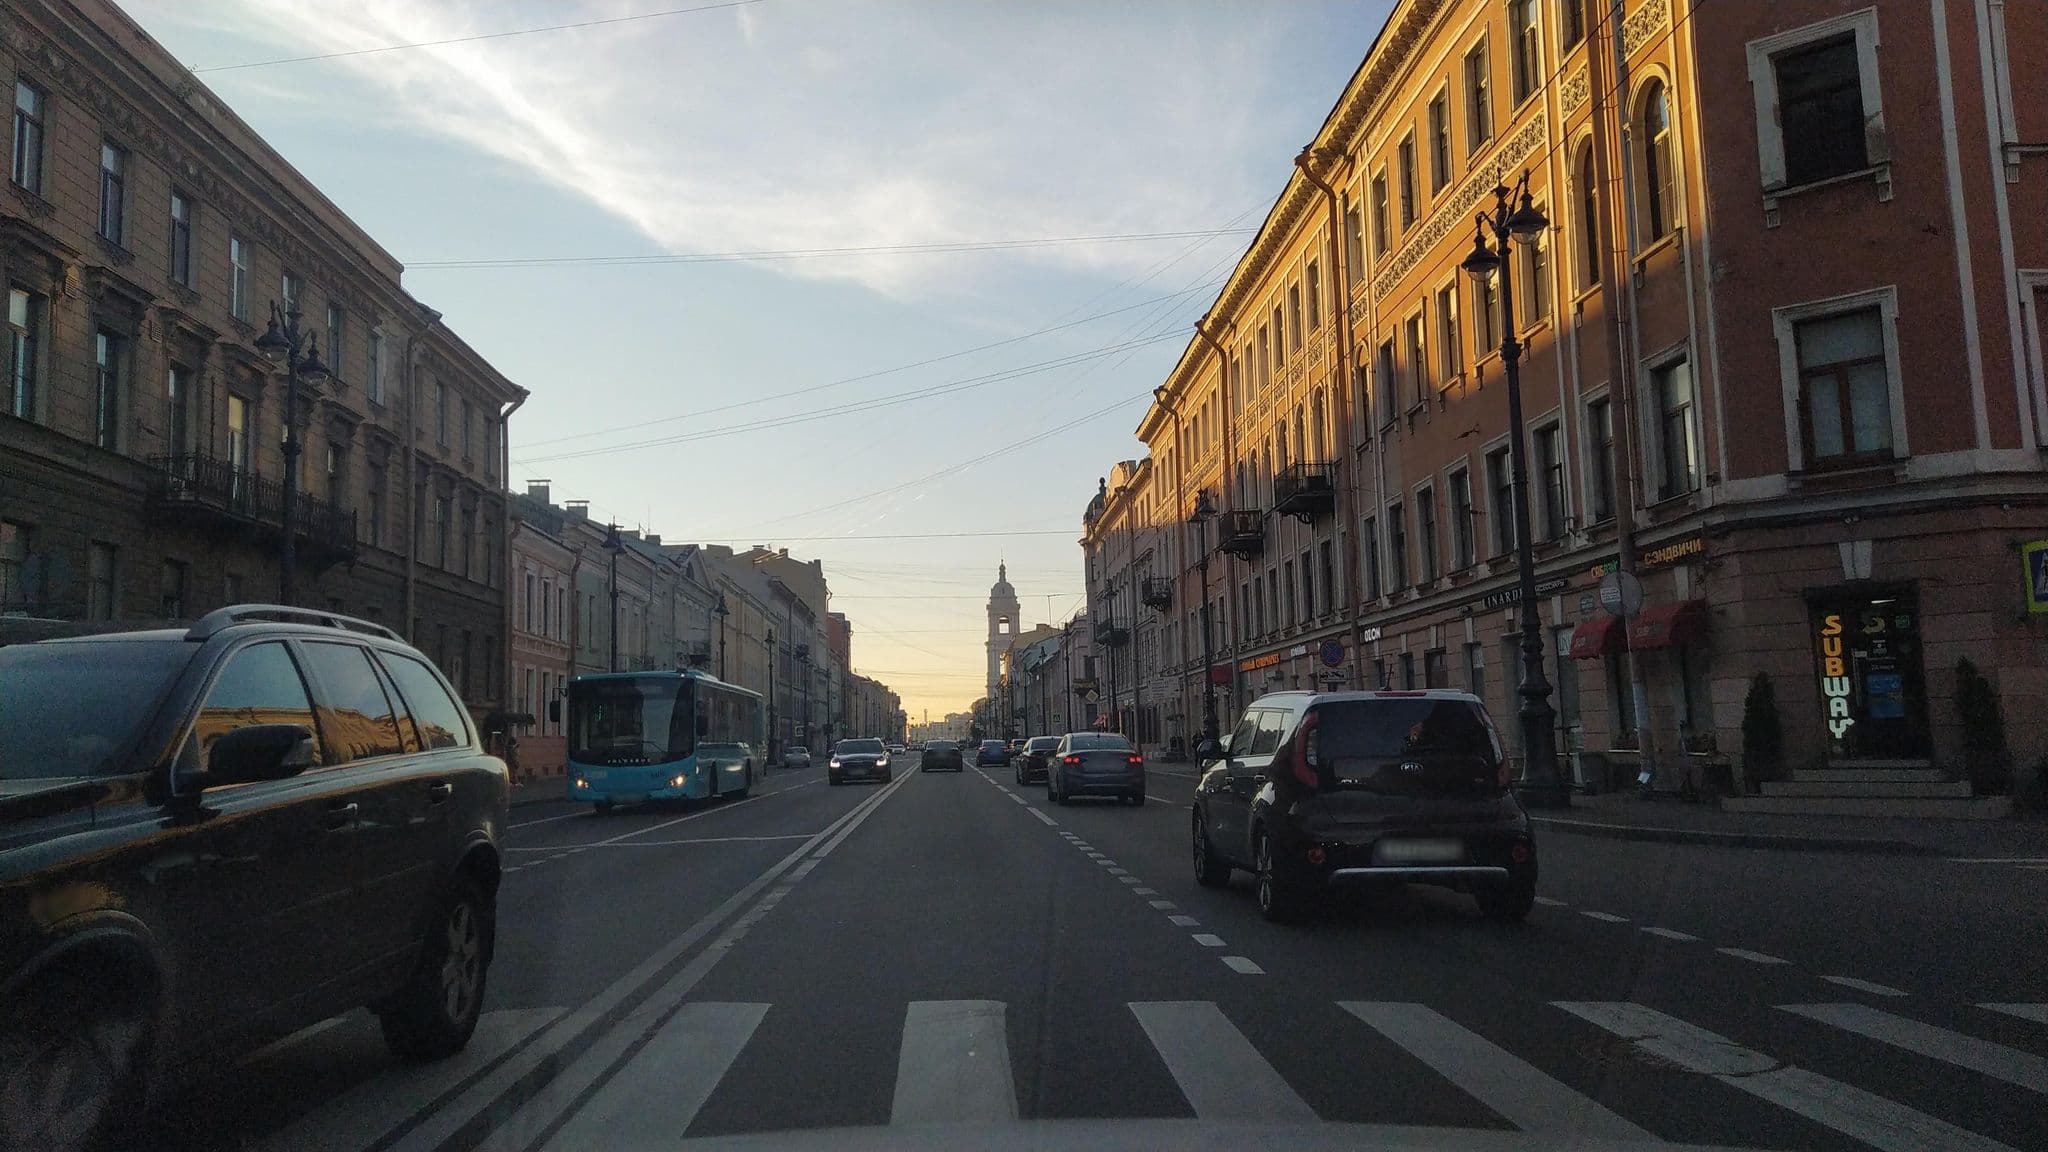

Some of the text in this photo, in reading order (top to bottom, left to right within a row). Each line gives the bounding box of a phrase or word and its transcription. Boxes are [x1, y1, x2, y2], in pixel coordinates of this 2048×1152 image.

[1644, 538, 1703, 566] СЭНДВИЧИ
[1364, 626, 1381, 643] OZON
[1820, 614, 1855, 739] SUBWAY
